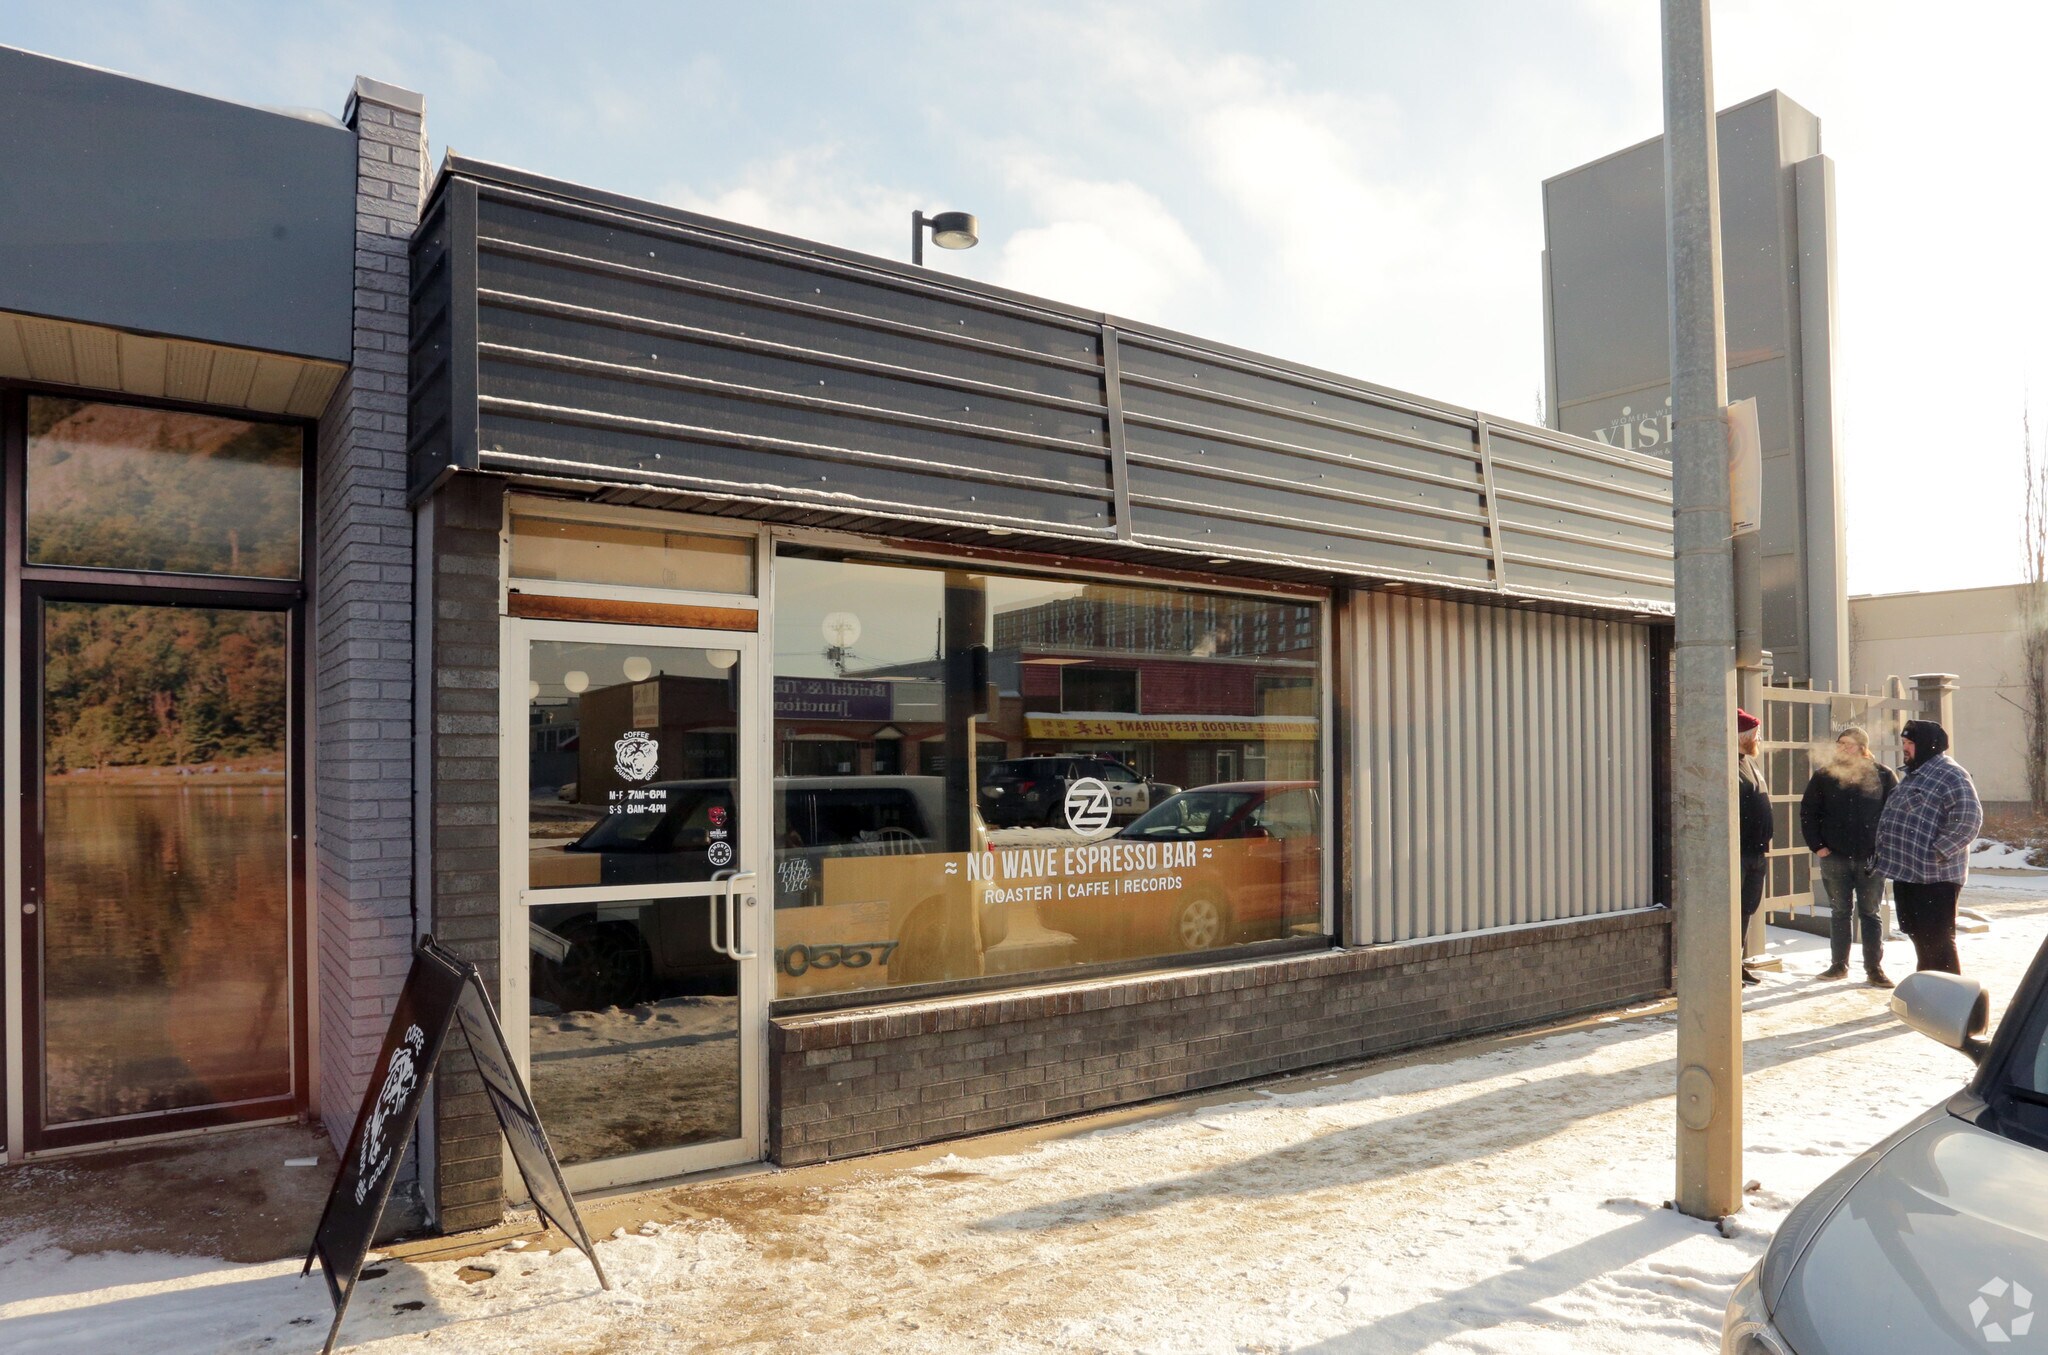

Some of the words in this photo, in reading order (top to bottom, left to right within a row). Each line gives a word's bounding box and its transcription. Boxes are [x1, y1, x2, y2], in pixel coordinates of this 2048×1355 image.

[1611, 413, 1648, 426] WOMEN
[623, 731, 650, 740] COFFEE
[614, 764, 634, 782] SOUNDS
[609, 790, 623, 800] M-F
[628, 789, 667, 799] 7AM-6PM
[609, 804, 622, 815] S-S
[627, 803, 667, 814] 8AM-4PM
[778, 859, 808, 874] HATE
[967, 851, 994, 882] NO
[1001, 848, 1058, 879] WAVE
[1064, 843, 1157, 876] ESPRESSO
[1162, 841, 1197, 869] BAR
[781, 867, 812, 882] FREE
[784, 880, 808, 893] YEG
[985, 885, 1053, 905] ROASTER
[1067, 881, 1110, 898] CAFFE
[1124, 876, 1182, 894] RECORDS
[405, 1024, 424, 1056] COFFEE
